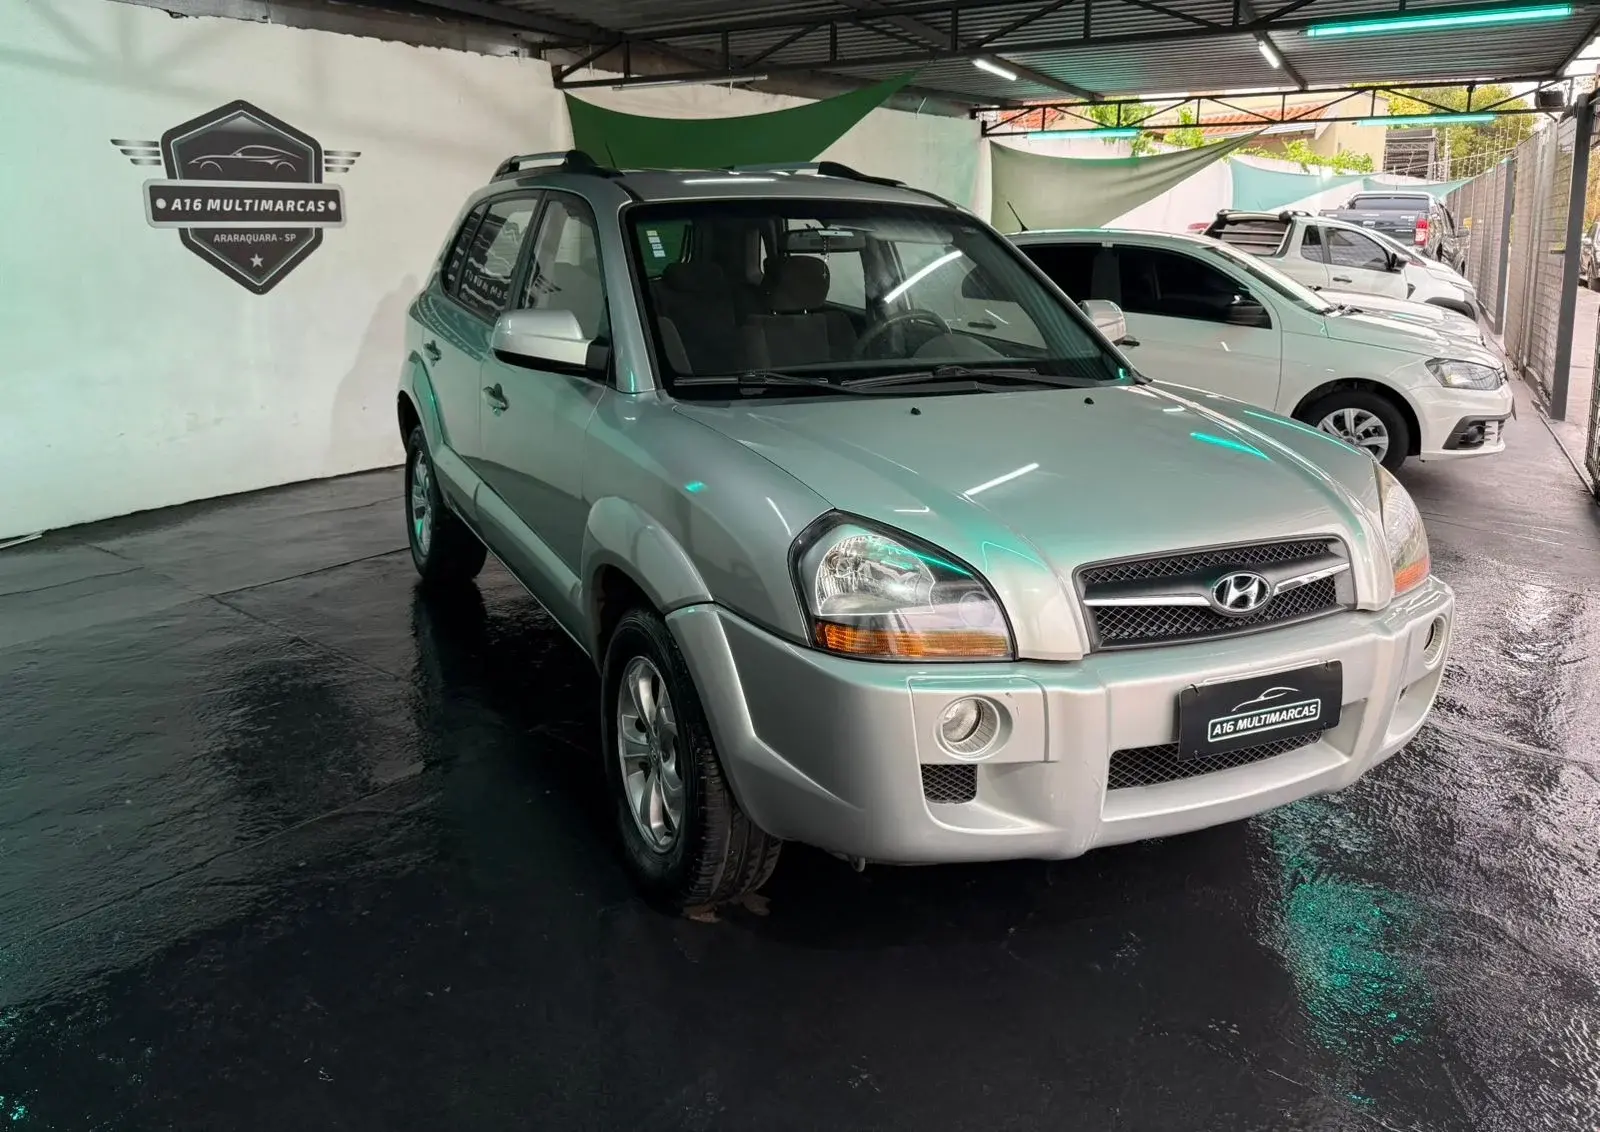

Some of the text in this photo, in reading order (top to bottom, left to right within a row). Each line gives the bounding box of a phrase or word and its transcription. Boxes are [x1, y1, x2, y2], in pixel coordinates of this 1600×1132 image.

[171, 198, 326, 212] A16 MULTIMARCAS
[213, 233, 278, 244] ARARAQUARA
[284, 233, 297, 242] SP
[1212, 704, 1318, 736] A16 MULTIMARCAS
